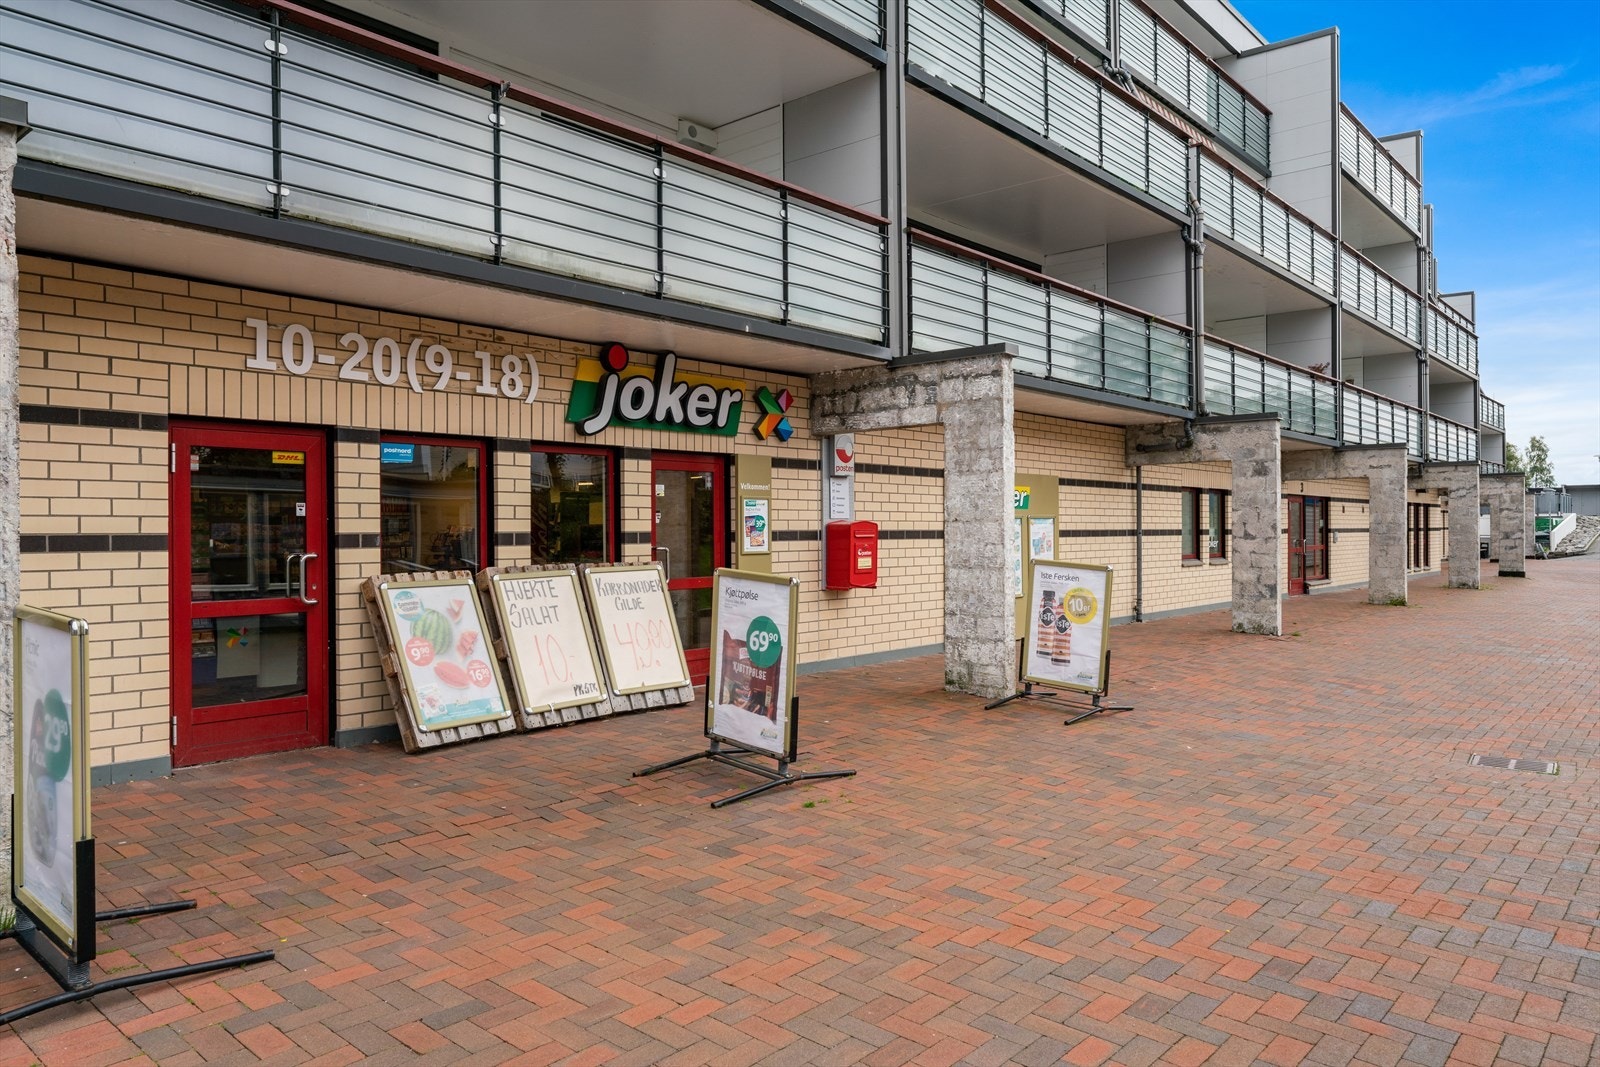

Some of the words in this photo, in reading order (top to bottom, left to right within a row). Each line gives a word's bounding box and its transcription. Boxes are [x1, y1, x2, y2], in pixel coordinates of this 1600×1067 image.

[580, 343, 743, 435] joker
[1040, 572, 1053, 580] Iste
[1053, 573, 1080, 582] Fersken
[725, 586, 759, 601] Kjøttpølse
[614, 597, 645, 611] GILDE
[509, 603, 560, 628] SALAT
[732, 661, 767, 681] KJØTTPØLSE
